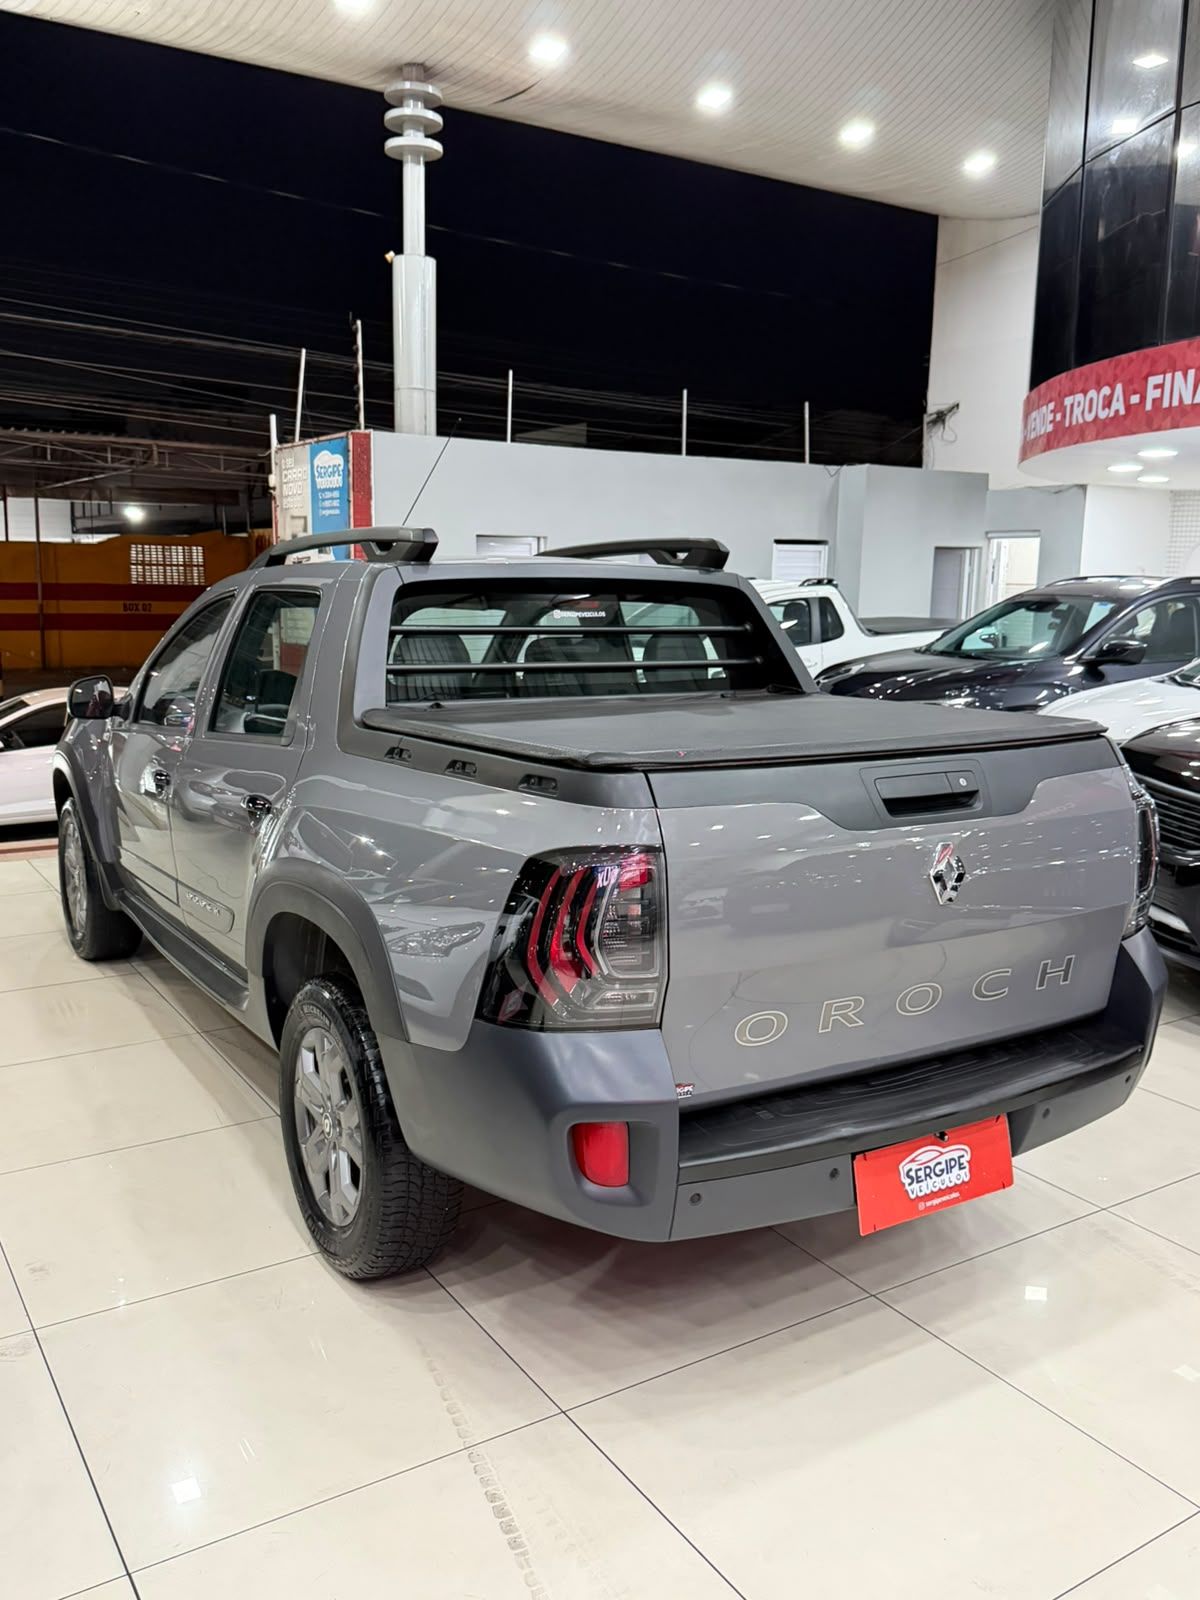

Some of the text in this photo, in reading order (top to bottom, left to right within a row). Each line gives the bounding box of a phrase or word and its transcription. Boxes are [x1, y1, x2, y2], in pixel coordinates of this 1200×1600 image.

[1063, 383, 1126, 427] TROCA
[123, 603, 152, 612] BOX 02
[734, 955, 1076, 1046] OROCH
[905, 1154, 967, 1187] SERGIPE
